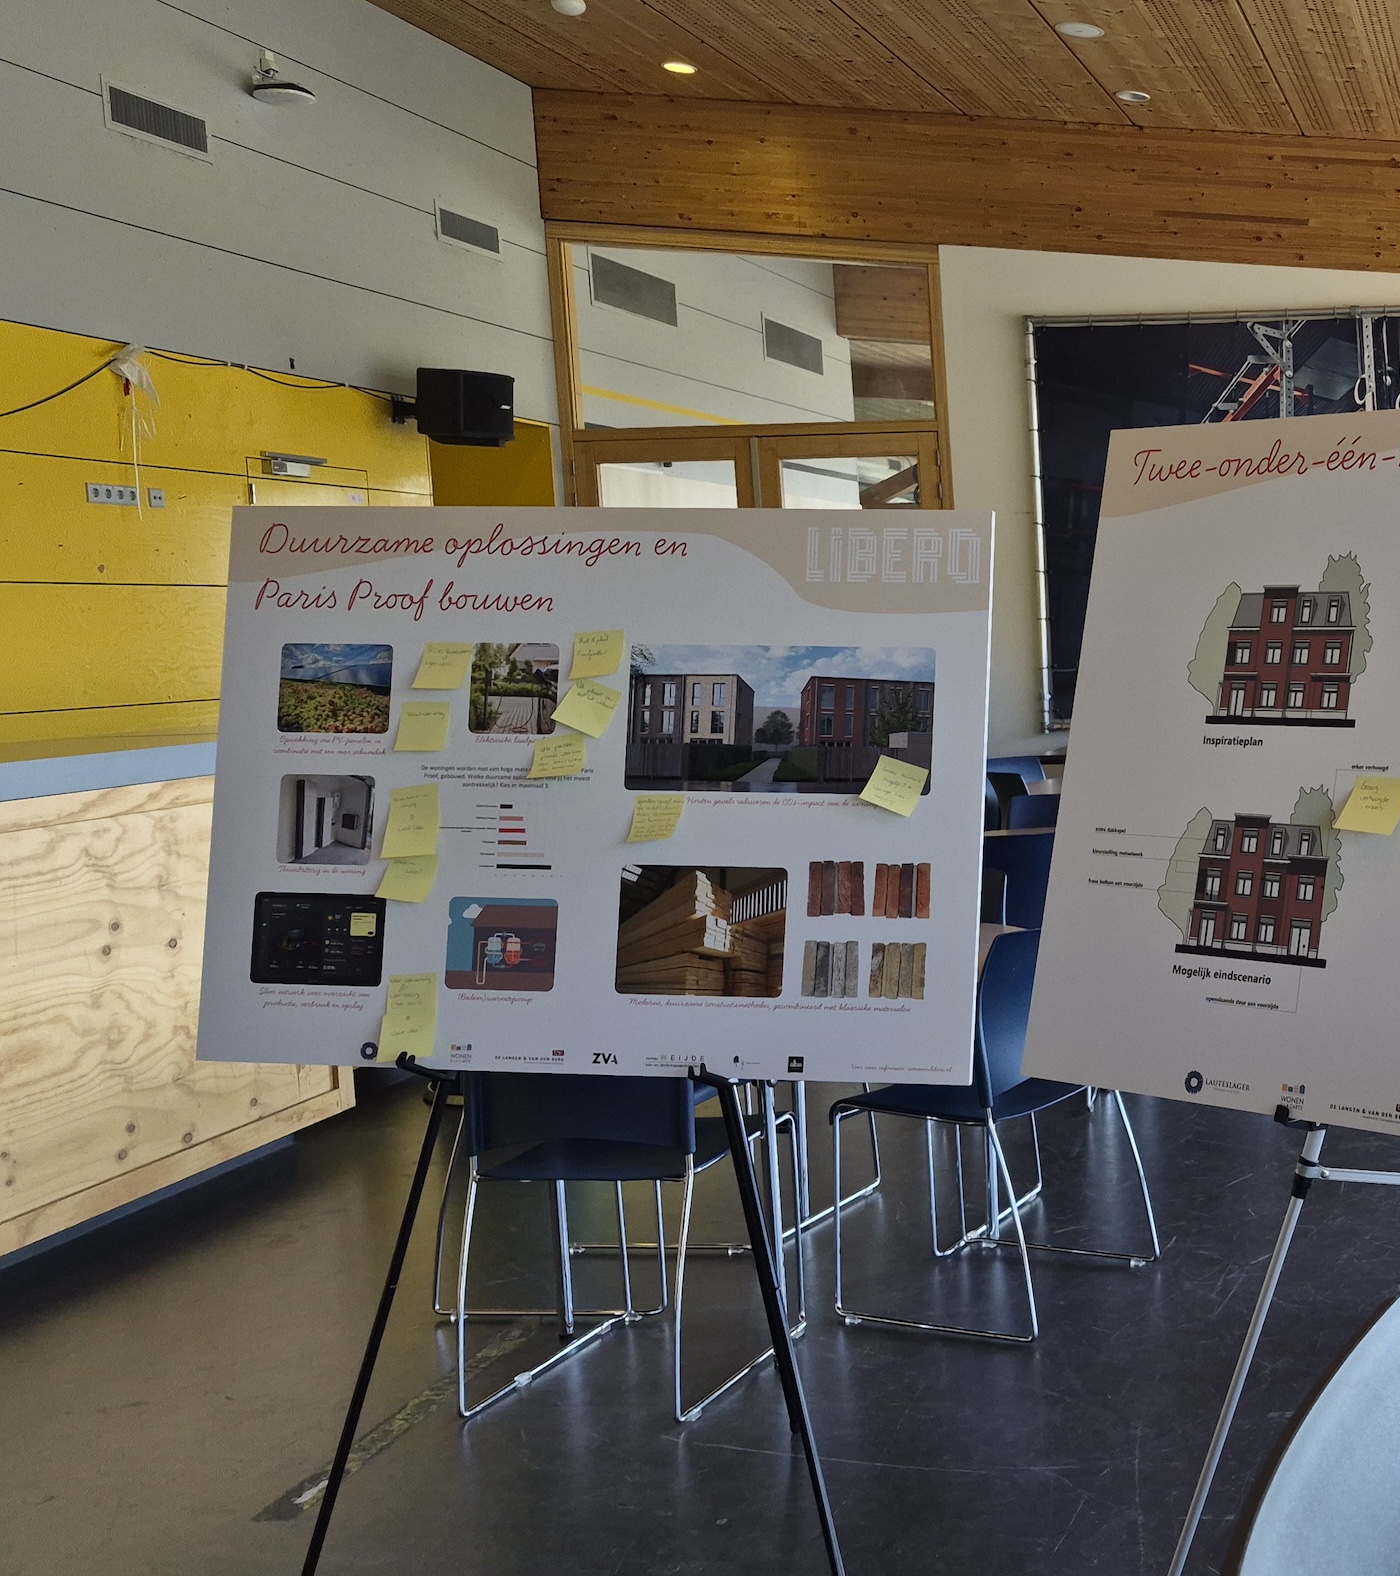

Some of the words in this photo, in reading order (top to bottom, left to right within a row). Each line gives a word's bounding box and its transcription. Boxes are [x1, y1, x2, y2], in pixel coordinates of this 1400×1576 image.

[259, 523, 433, 555] Duurzame
[445, 523, 641, 568] oplossingen
[654, 538, 688, 557] en
[255, 577, 337, 610] Paris
[347, 578, 434, 621] Proof
[439, 581, 554, 613] bouwen
[475, 735, 513, 744] Elektrische
[1203, 735, 1264, 749] Inspiratieplan
[687, 796, 712, 805] Houten
[713, 797, 736, 806] gevels
[737, 797, 771, 806] reduceren
[851, 801, 879, 809] woning
[341, 869, 366, 877] woning
[1172, 964, 1211, 980] Mogelijk
[1213, 969, 1271, 985] eindscenario
[259, 987, 277, 995] Slim
[278, 988, 305, 996] netwerk
[323, 990, 357, 998] overzicht
[263, 1000, 298, 1009] productie,
[300, 1000, 330, 1008] verbruik
[341, 1002, 364, 1011] opslag
[629, 998, 663, 1007] Moderne,
[665, 999, 703, 1007] duurzame
[772, 1003, 822, 1011] gecombineerd
[873, 1005, 911, 1013] materialen
[1205, 996, 1235, 1004] openslaande
[1257, 1002, 1279, 1010] voorzijde
[592, 1053, 618, 1065] ZVA
[1205, 1078, 1250, 1092] LAUTESLAGER
[1280, 1095, 1305, 1105] WONEN
[1338, 1105, 1360, 1113] LANGEN
[1368, 1109, 1379, 1117] VAN
